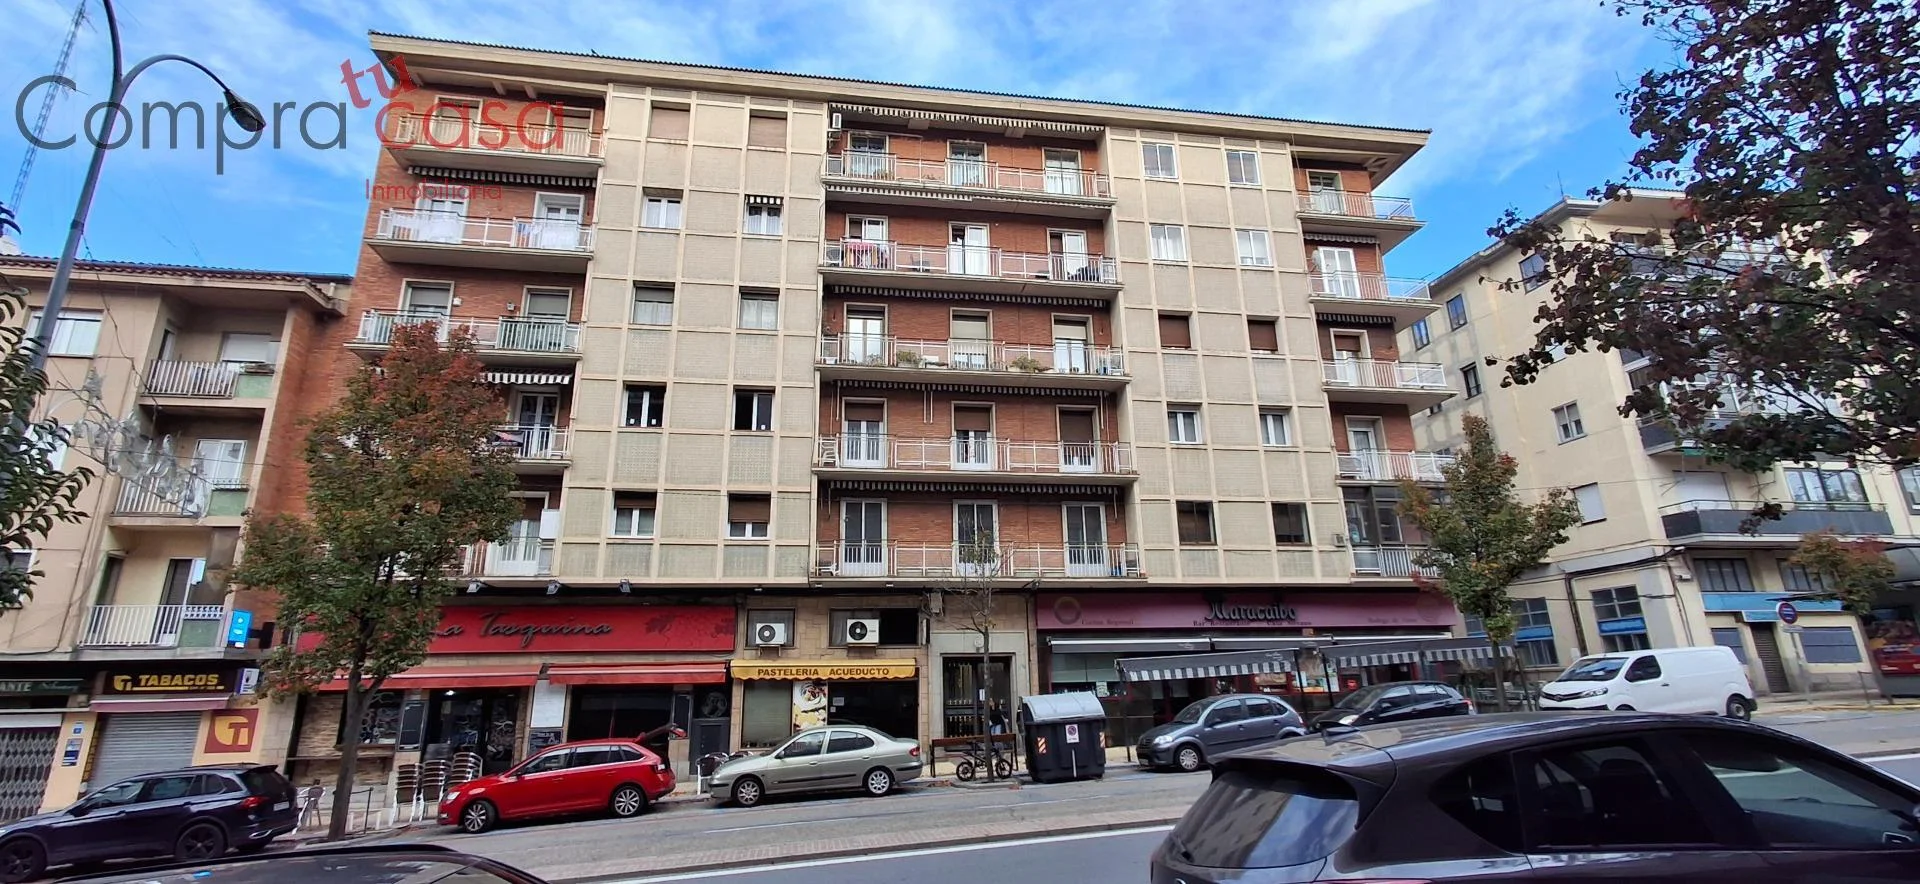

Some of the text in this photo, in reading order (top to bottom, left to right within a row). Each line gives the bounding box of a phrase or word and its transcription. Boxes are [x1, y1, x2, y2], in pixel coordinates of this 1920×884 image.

[1205, 601, 1297, 621] Maracaibo
[757, 668, 890, 676] PASTELERIA ACUEDUCTO
[138, 674, 220, 686] TABACOS
